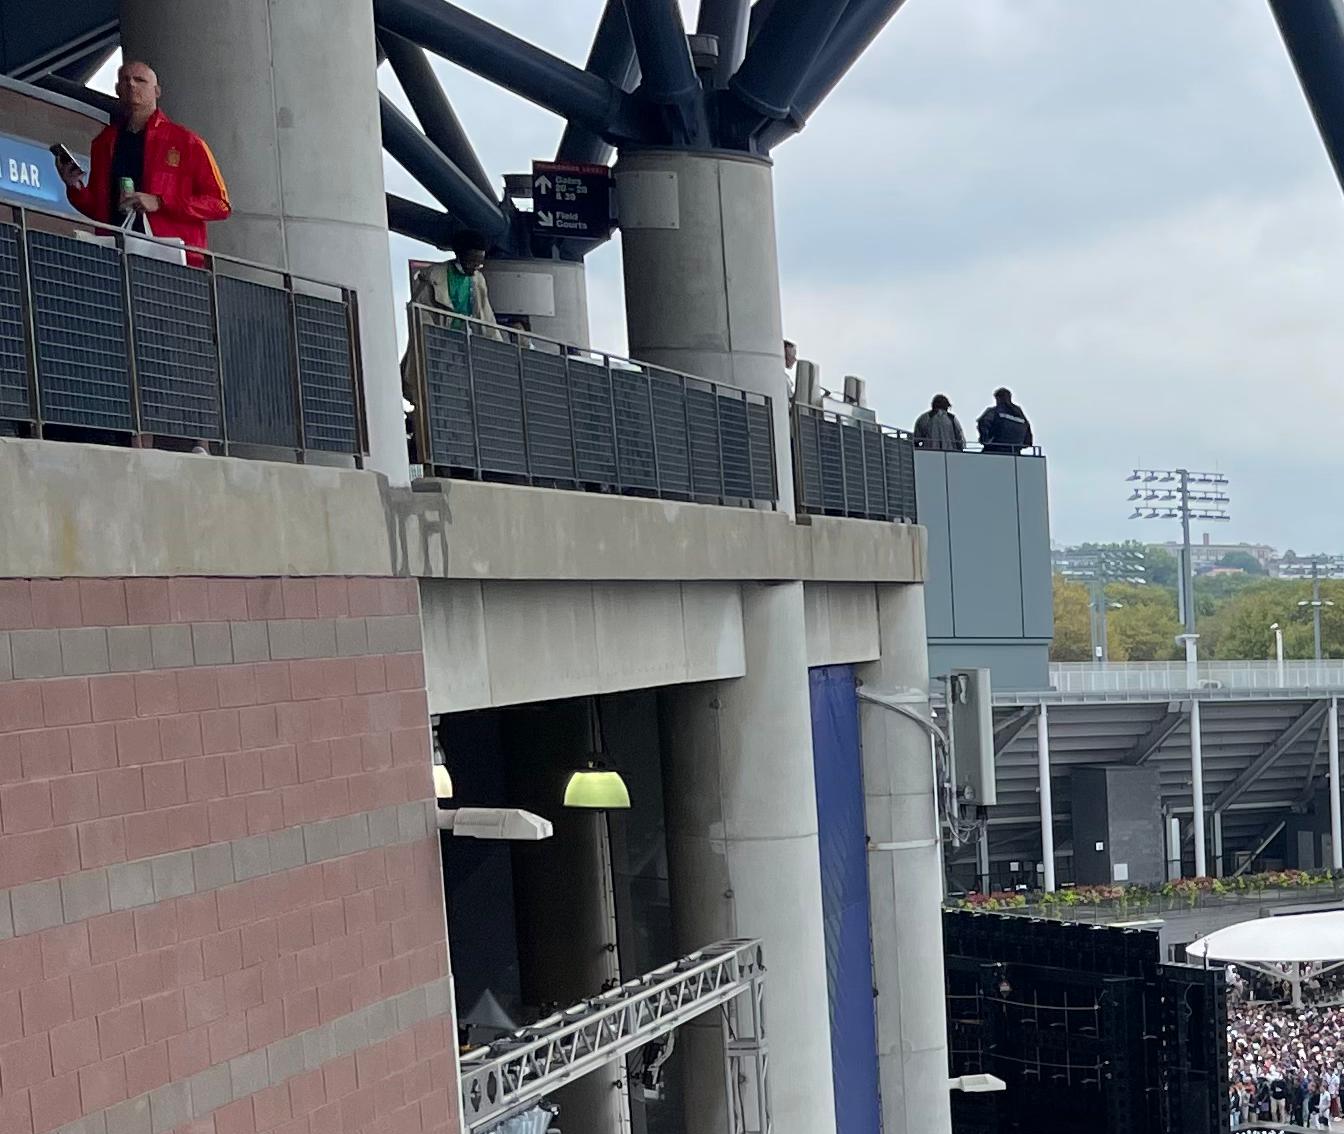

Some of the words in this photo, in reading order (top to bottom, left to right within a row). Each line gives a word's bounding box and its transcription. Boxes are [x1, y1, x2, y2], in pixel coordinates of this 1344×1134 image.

[9, 158, 40, 188] BAR
[556, 211, 578, 220] Field
[556, 219, 588, 229] Courts
